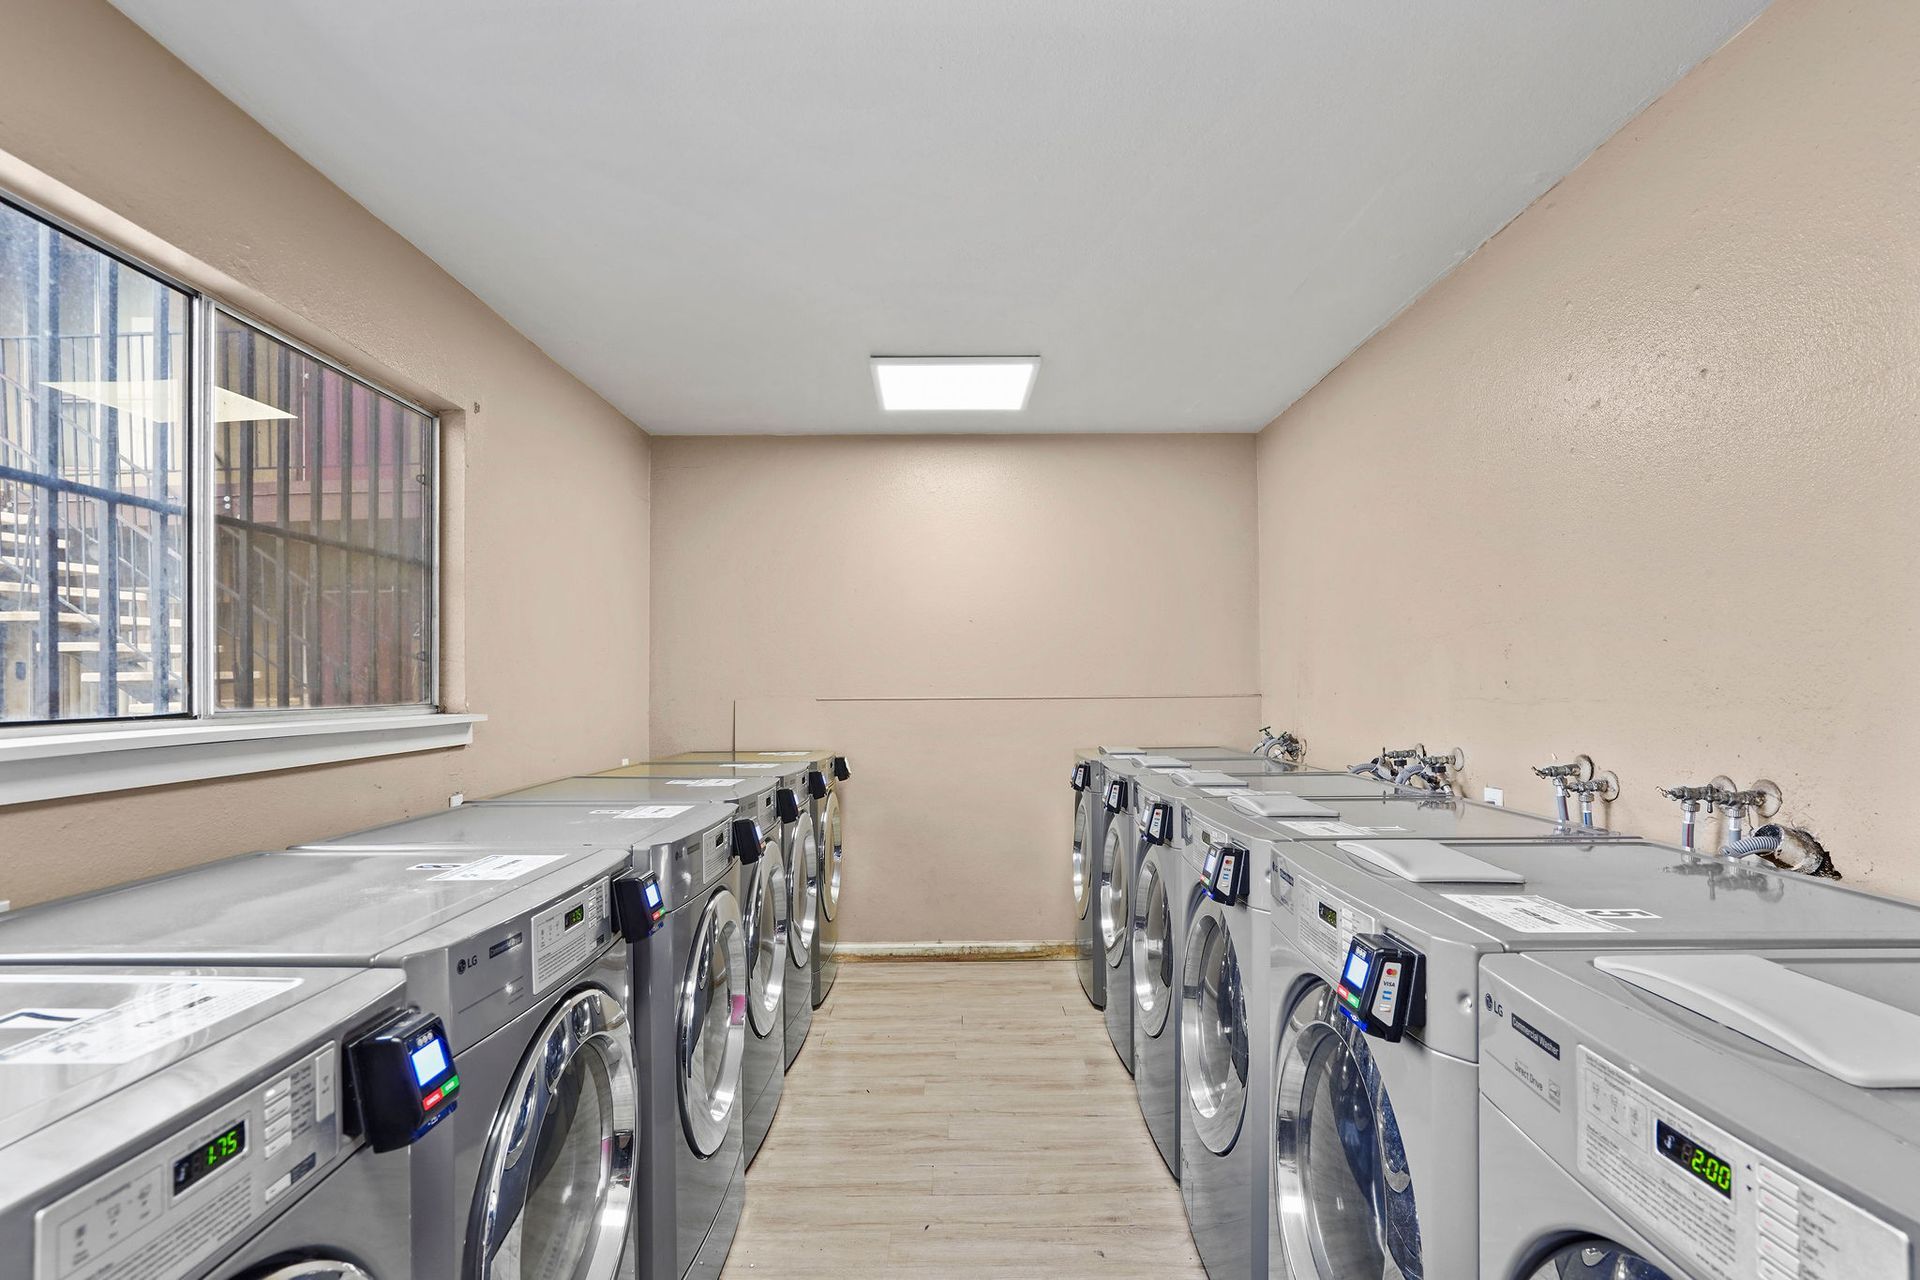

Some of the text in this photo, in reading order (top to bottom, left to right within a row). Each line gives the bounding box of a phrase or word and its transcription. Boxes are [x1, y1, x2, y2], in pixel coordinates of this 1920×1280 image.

[467, 955, 478, 968] LG
[1494, 1000, 1504, 1018] LG
[1512, 1016, 1559, 1056] Commercial Washer
[1514, 1061, 1543, 1091] Direct Drive
[1691, 1149, 1732, 1191] 2.00
